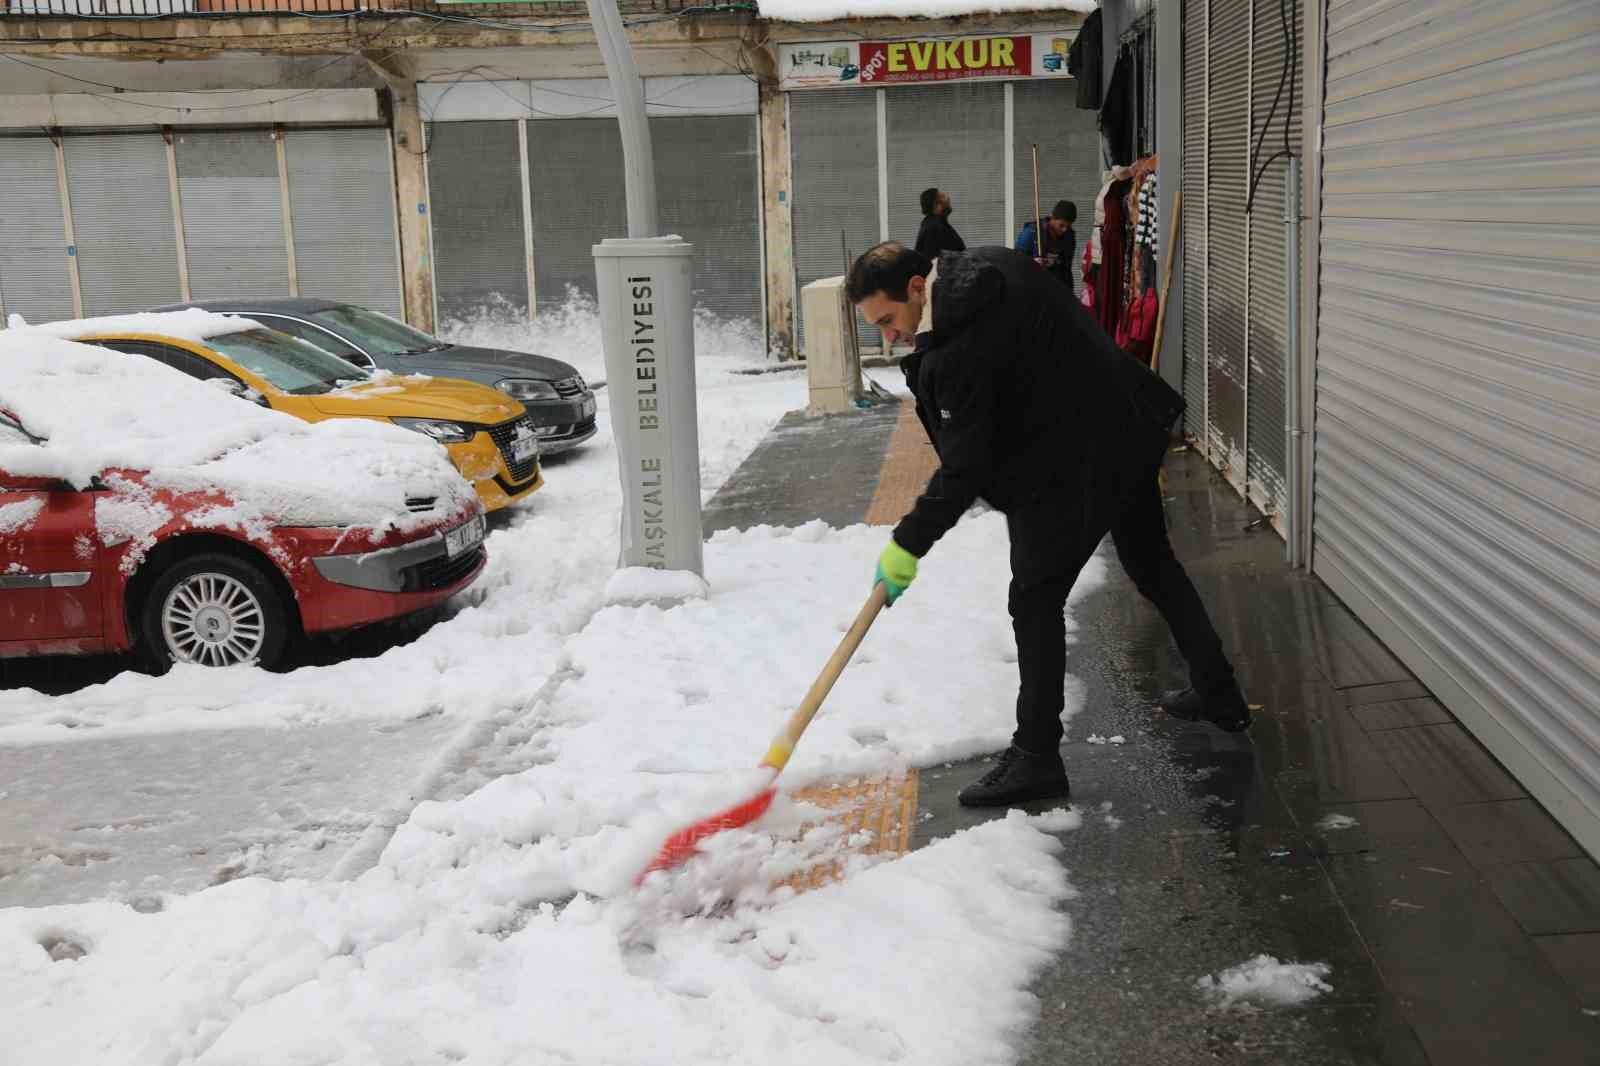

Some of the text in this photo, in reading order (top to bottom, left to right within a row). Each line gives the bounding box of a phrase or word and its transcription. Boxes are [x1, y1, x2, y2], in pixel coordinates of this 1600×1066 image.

[862, 38, 1014, 81] SPOT EVKUR
[627, 276, 659, 430] BELEDİYESİ
